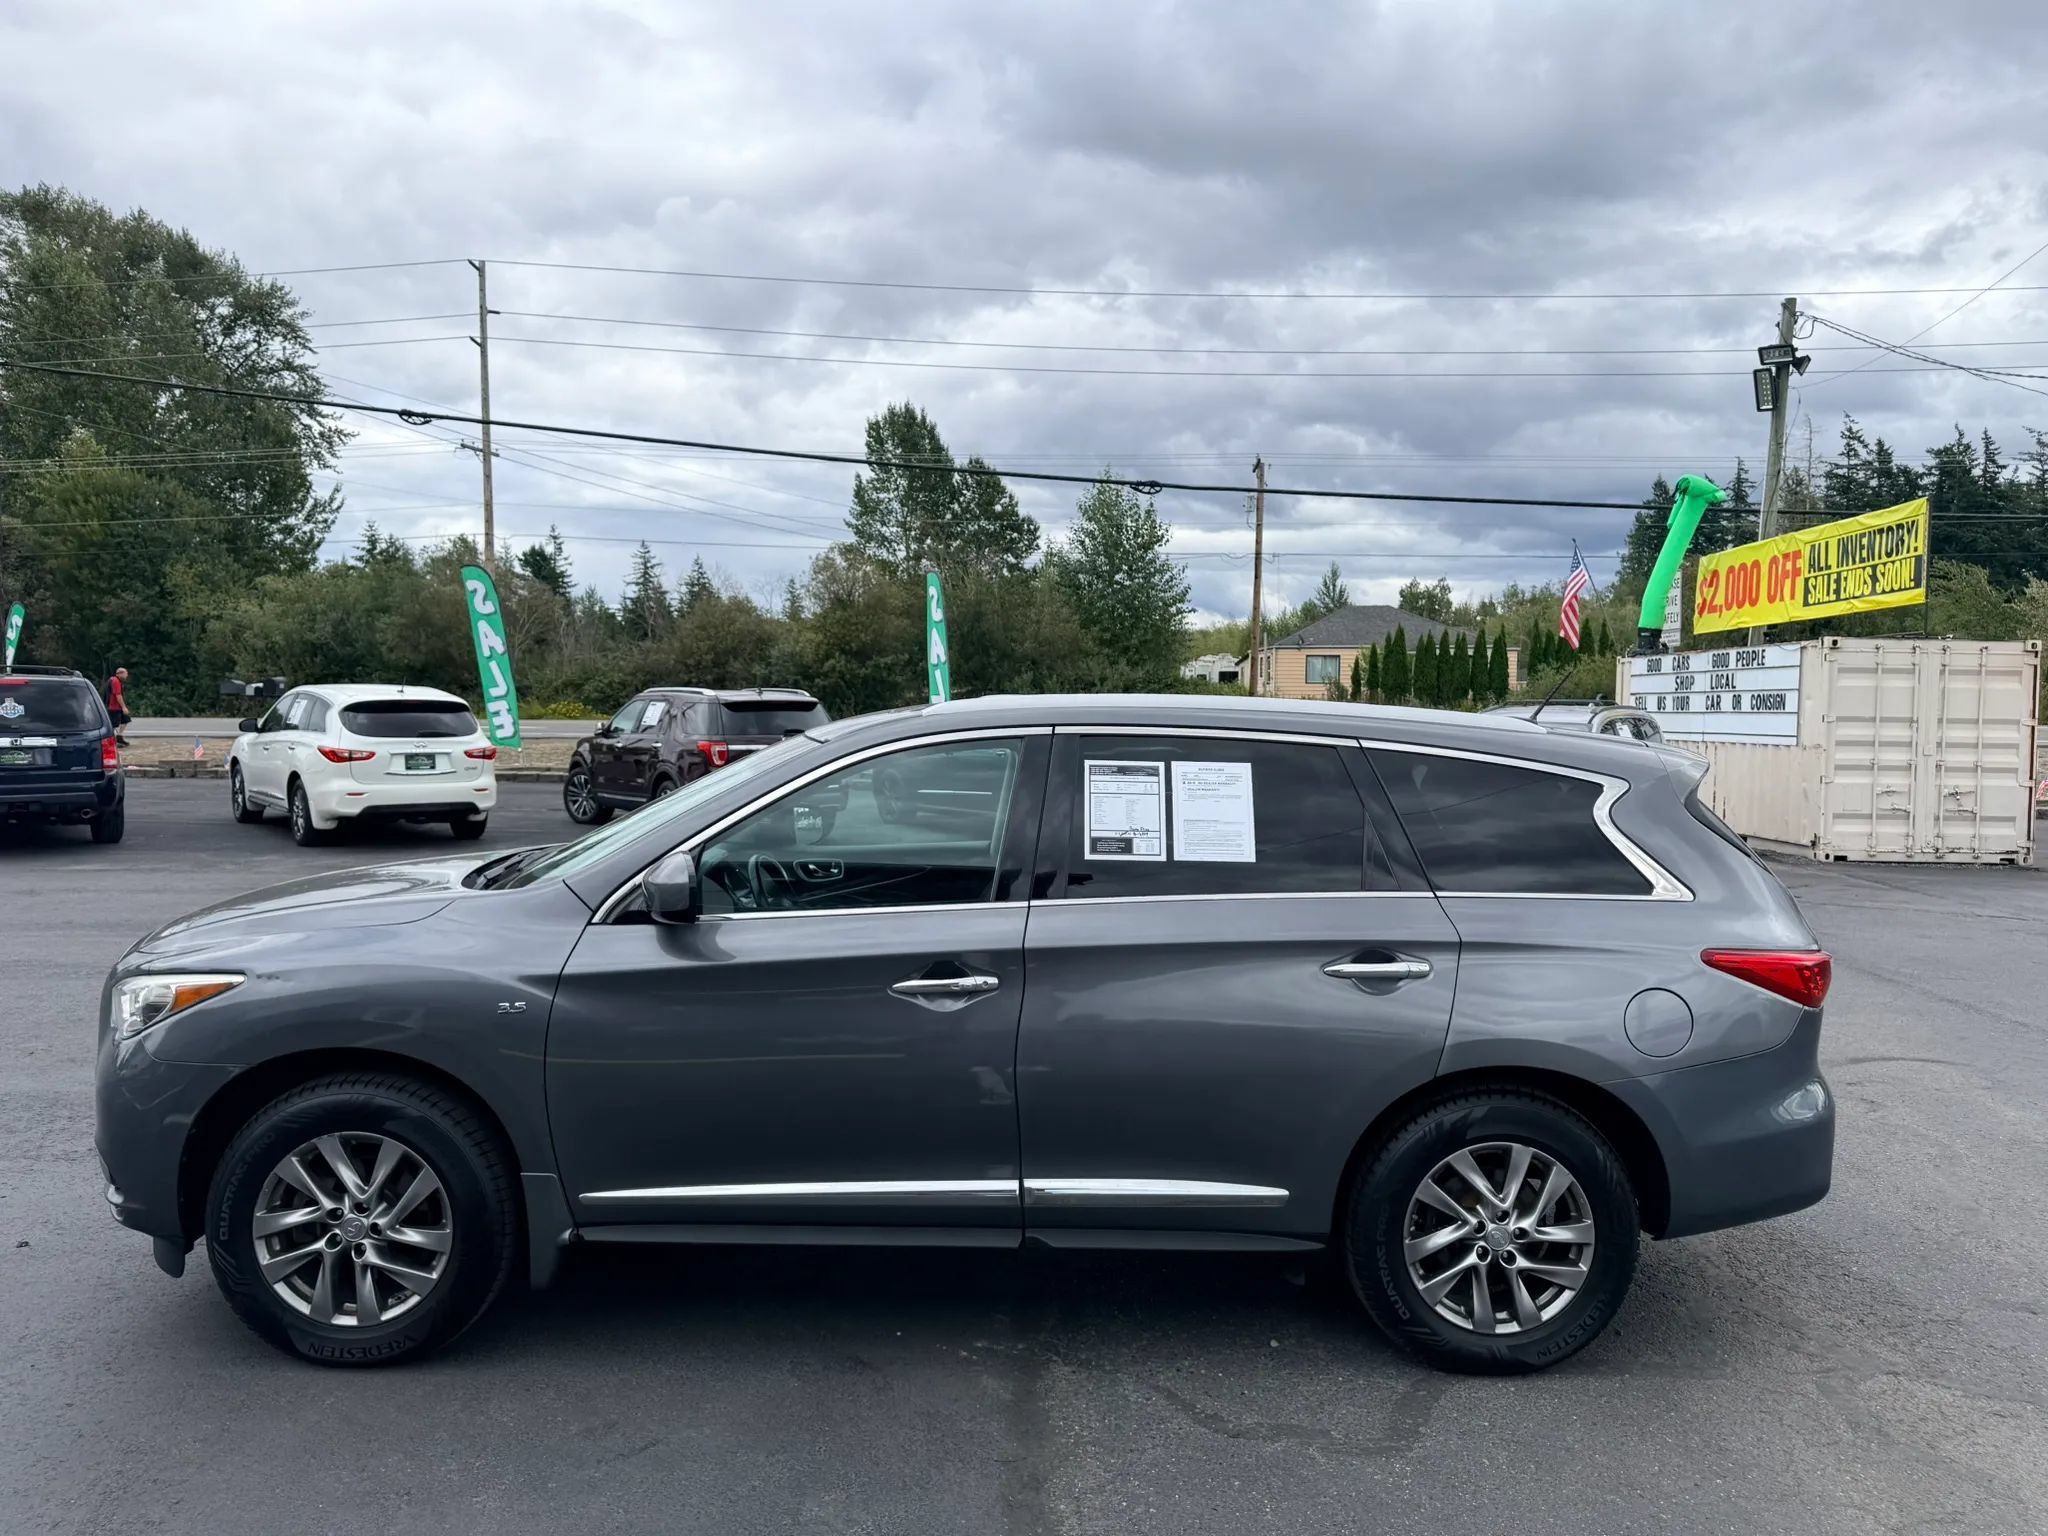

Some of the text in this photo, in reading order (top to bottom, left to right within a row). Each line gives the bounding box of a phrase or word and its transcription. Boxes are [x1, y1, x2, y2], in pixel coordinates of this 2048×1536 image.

[1808, 518, 1919, 575] ALL INVENTORY!
[1697, 549, 1803, 619] $2,000 OFF
[1808, 557, 1915, 605] SALE ENDS SOON!
[1647, 649, 1766, 673] GOOD CARS GOOD PEOPLE
[1675, 673, 1736, 691] SHOP LOCAL
[1634, 693, 1786, 711] SELL US YOUR CAR OR CONSIGN
